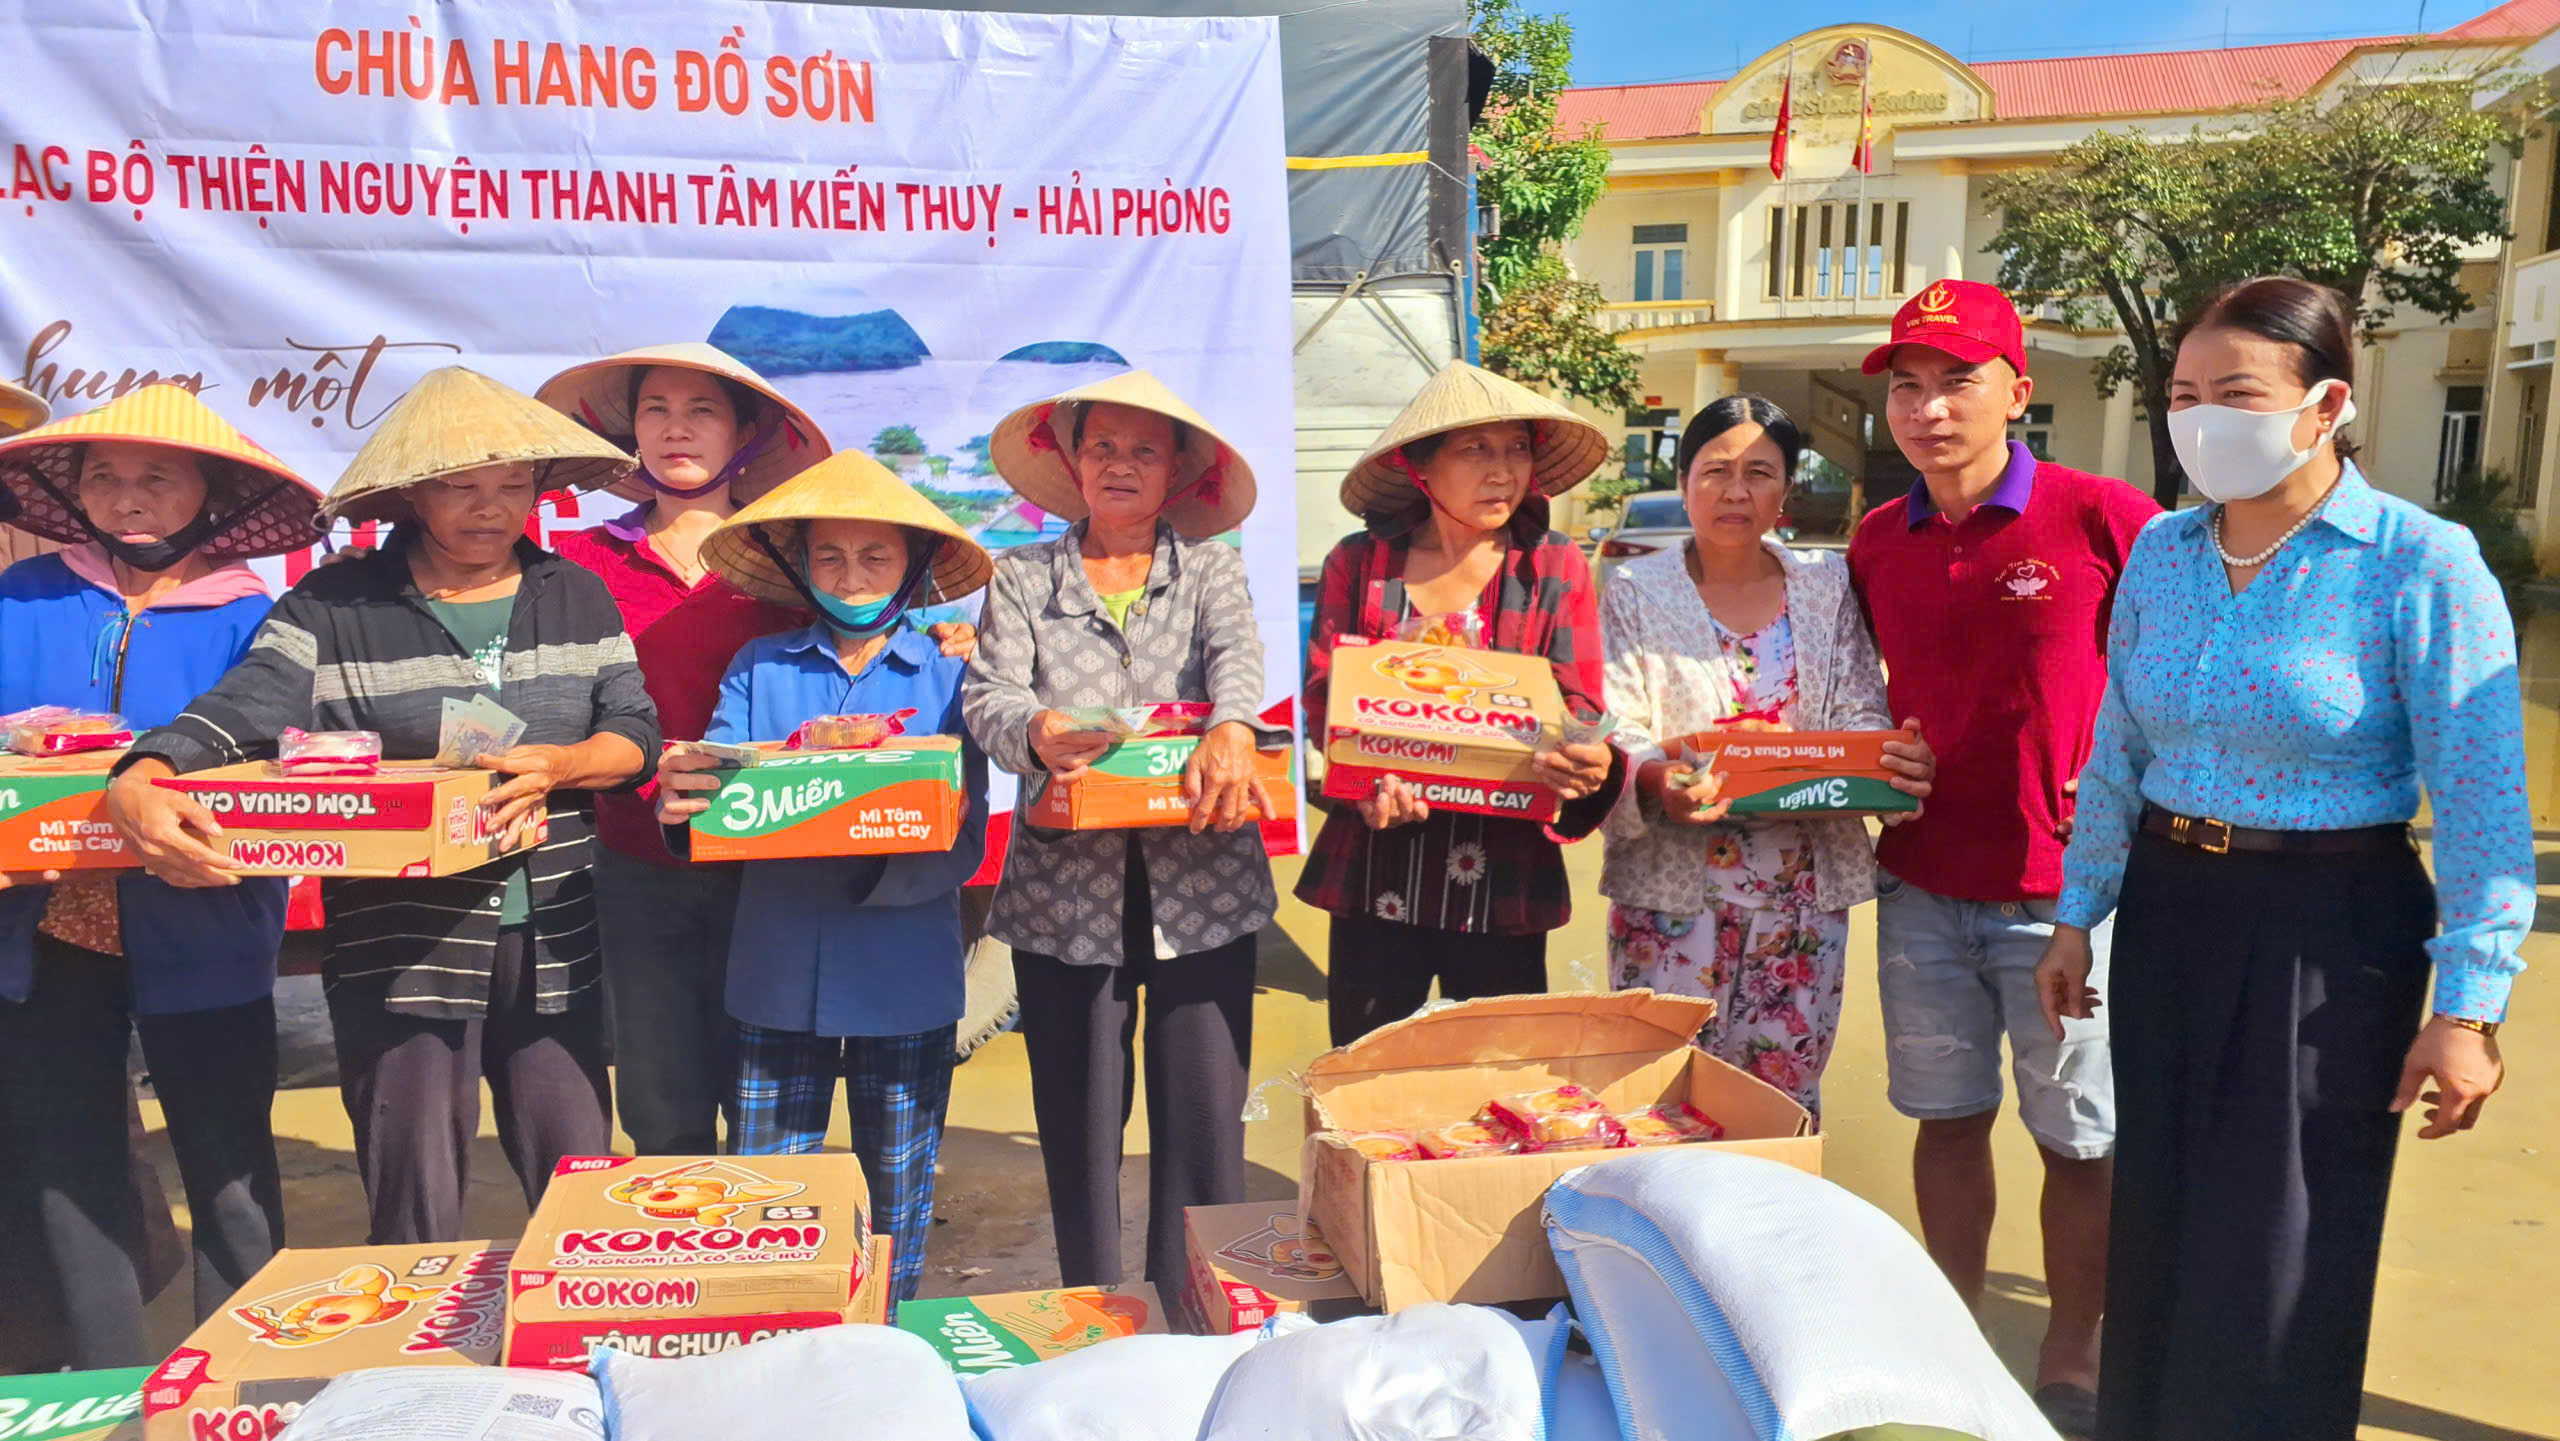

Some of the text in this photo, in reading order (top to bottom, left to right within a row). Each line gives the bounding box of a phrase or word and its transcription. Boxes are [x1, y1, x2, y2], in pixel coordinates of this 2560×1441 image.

[315, 15, 874, 123] CHÙA HANG ĐỒ SƠN
[0, 144, 72, 217] ẠC
[87, 139, 155, 222] BỘ
[166, 144, 304, 229] THIỆN
[320, 156, 509, 234] NGUYỆN
[521, 169, 676, 224] THANH
[687, 164, 779, 228] TÂM
[791, 164, 886, 233] KIẾN
[896, 183, 1003, 248] THUỴ
[1039, 170, 1101, 236] HẢI
[1112, 178, 1232, 237] PHÒNG
[1922, 314, 1960, 324] TRAVEL
[1355, 696, 1541, 734] KOKOMI
[1358, 734, 1457, 765] KOKOMI
[1724, 743, 1752, 758] Cay
[1754, 745, 1791, 758] Chua
[238, 791, 312, 814] CHUA
[316, 793, 377, 821] TÔM
[1425, 784, 1487, 806] CHUA
[1488, 791, 1534, 810] CAY
[859, 807, 923, 824] Mì Tôm
[39, 820, 113, 836] Mì Tôm
[849, 823, 931, 841] Chua Cay
[28, 836, 124, 854] Chua Cay
[231, 840, 346, 869] KOKOMI
[766, 1206, 813, 1220] 65
[559, 1224, 824, 1255] KOKOMI
[587, 1256, 665, 1265] KOKOMI
[403, 1247, 515, 1352] KOKOMI
[557, 1279, 698, 1308] KOKOMI
[658, 1332, 743, 1356] CHUA
